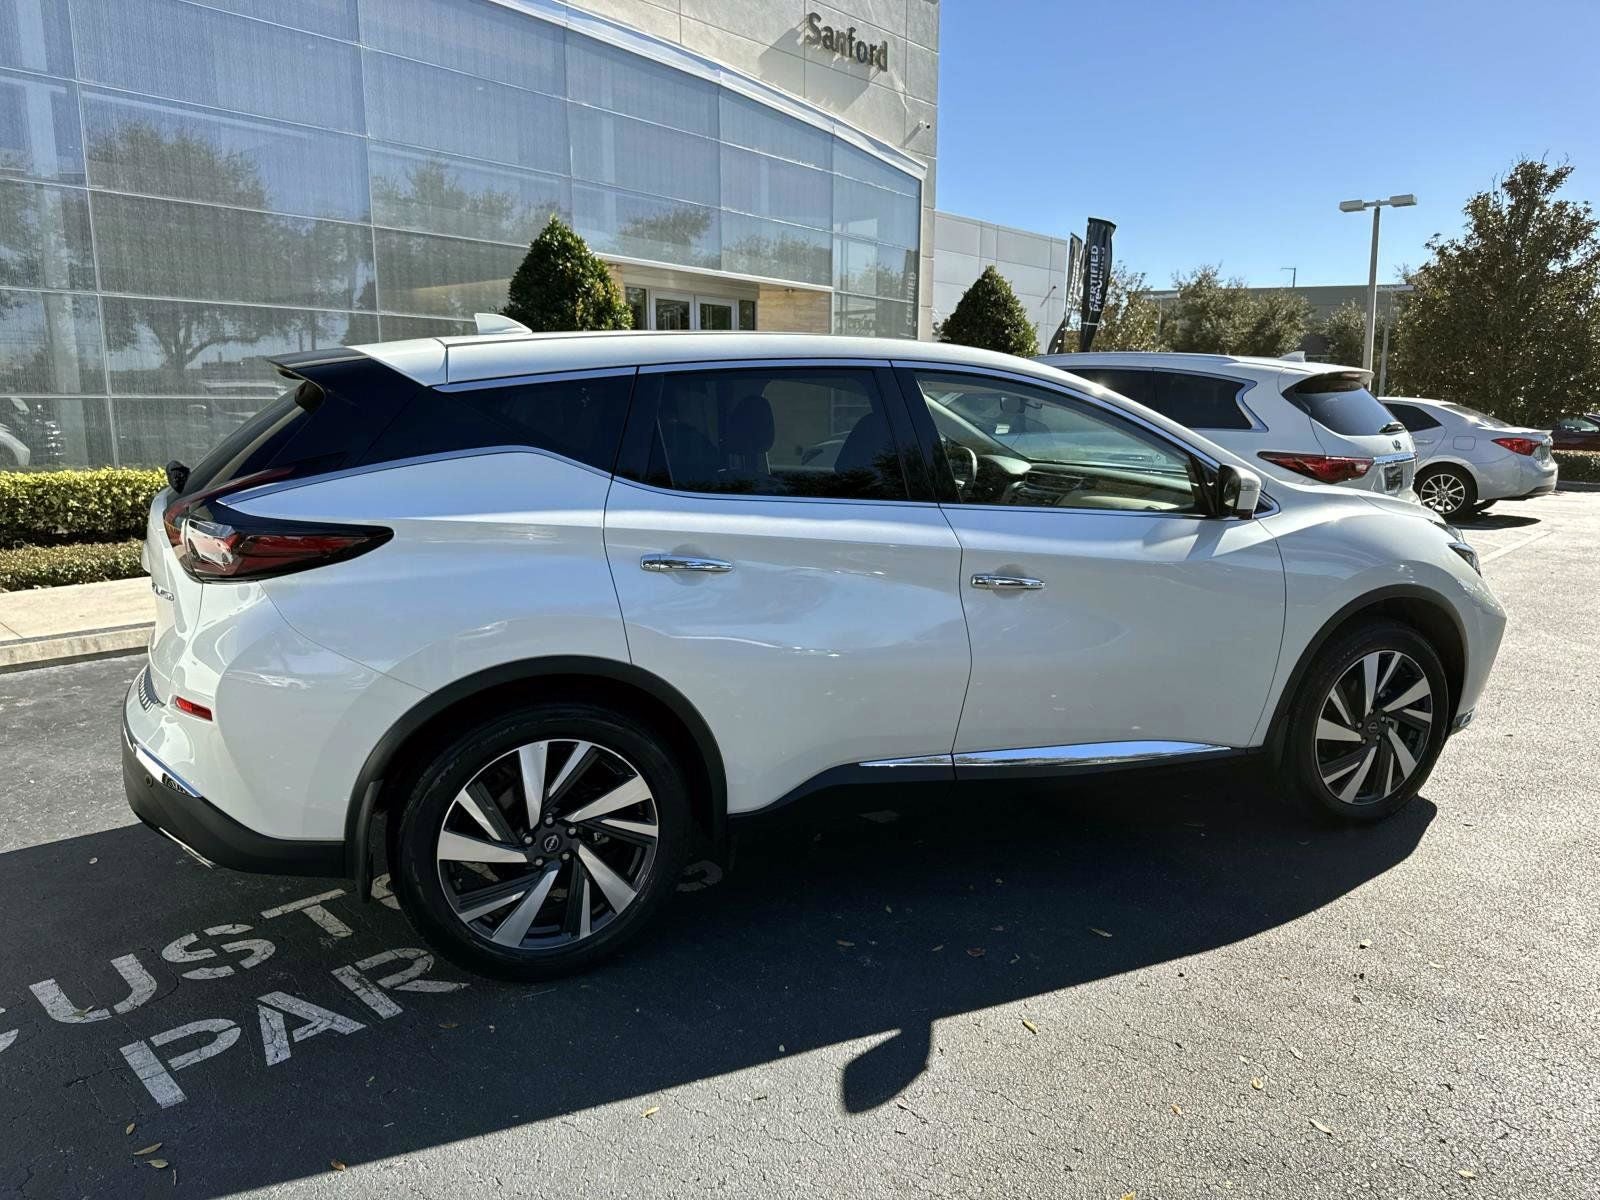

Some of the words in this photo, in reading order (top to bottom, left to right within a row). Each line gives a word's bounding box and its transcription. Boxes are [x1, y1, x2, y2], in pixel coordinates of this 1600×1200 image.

[804, 12, 888, 72] Sanford
[905, 271, 917, 326] CERIFIED
[1088, 245, 1099, 311] CERTIFIED
